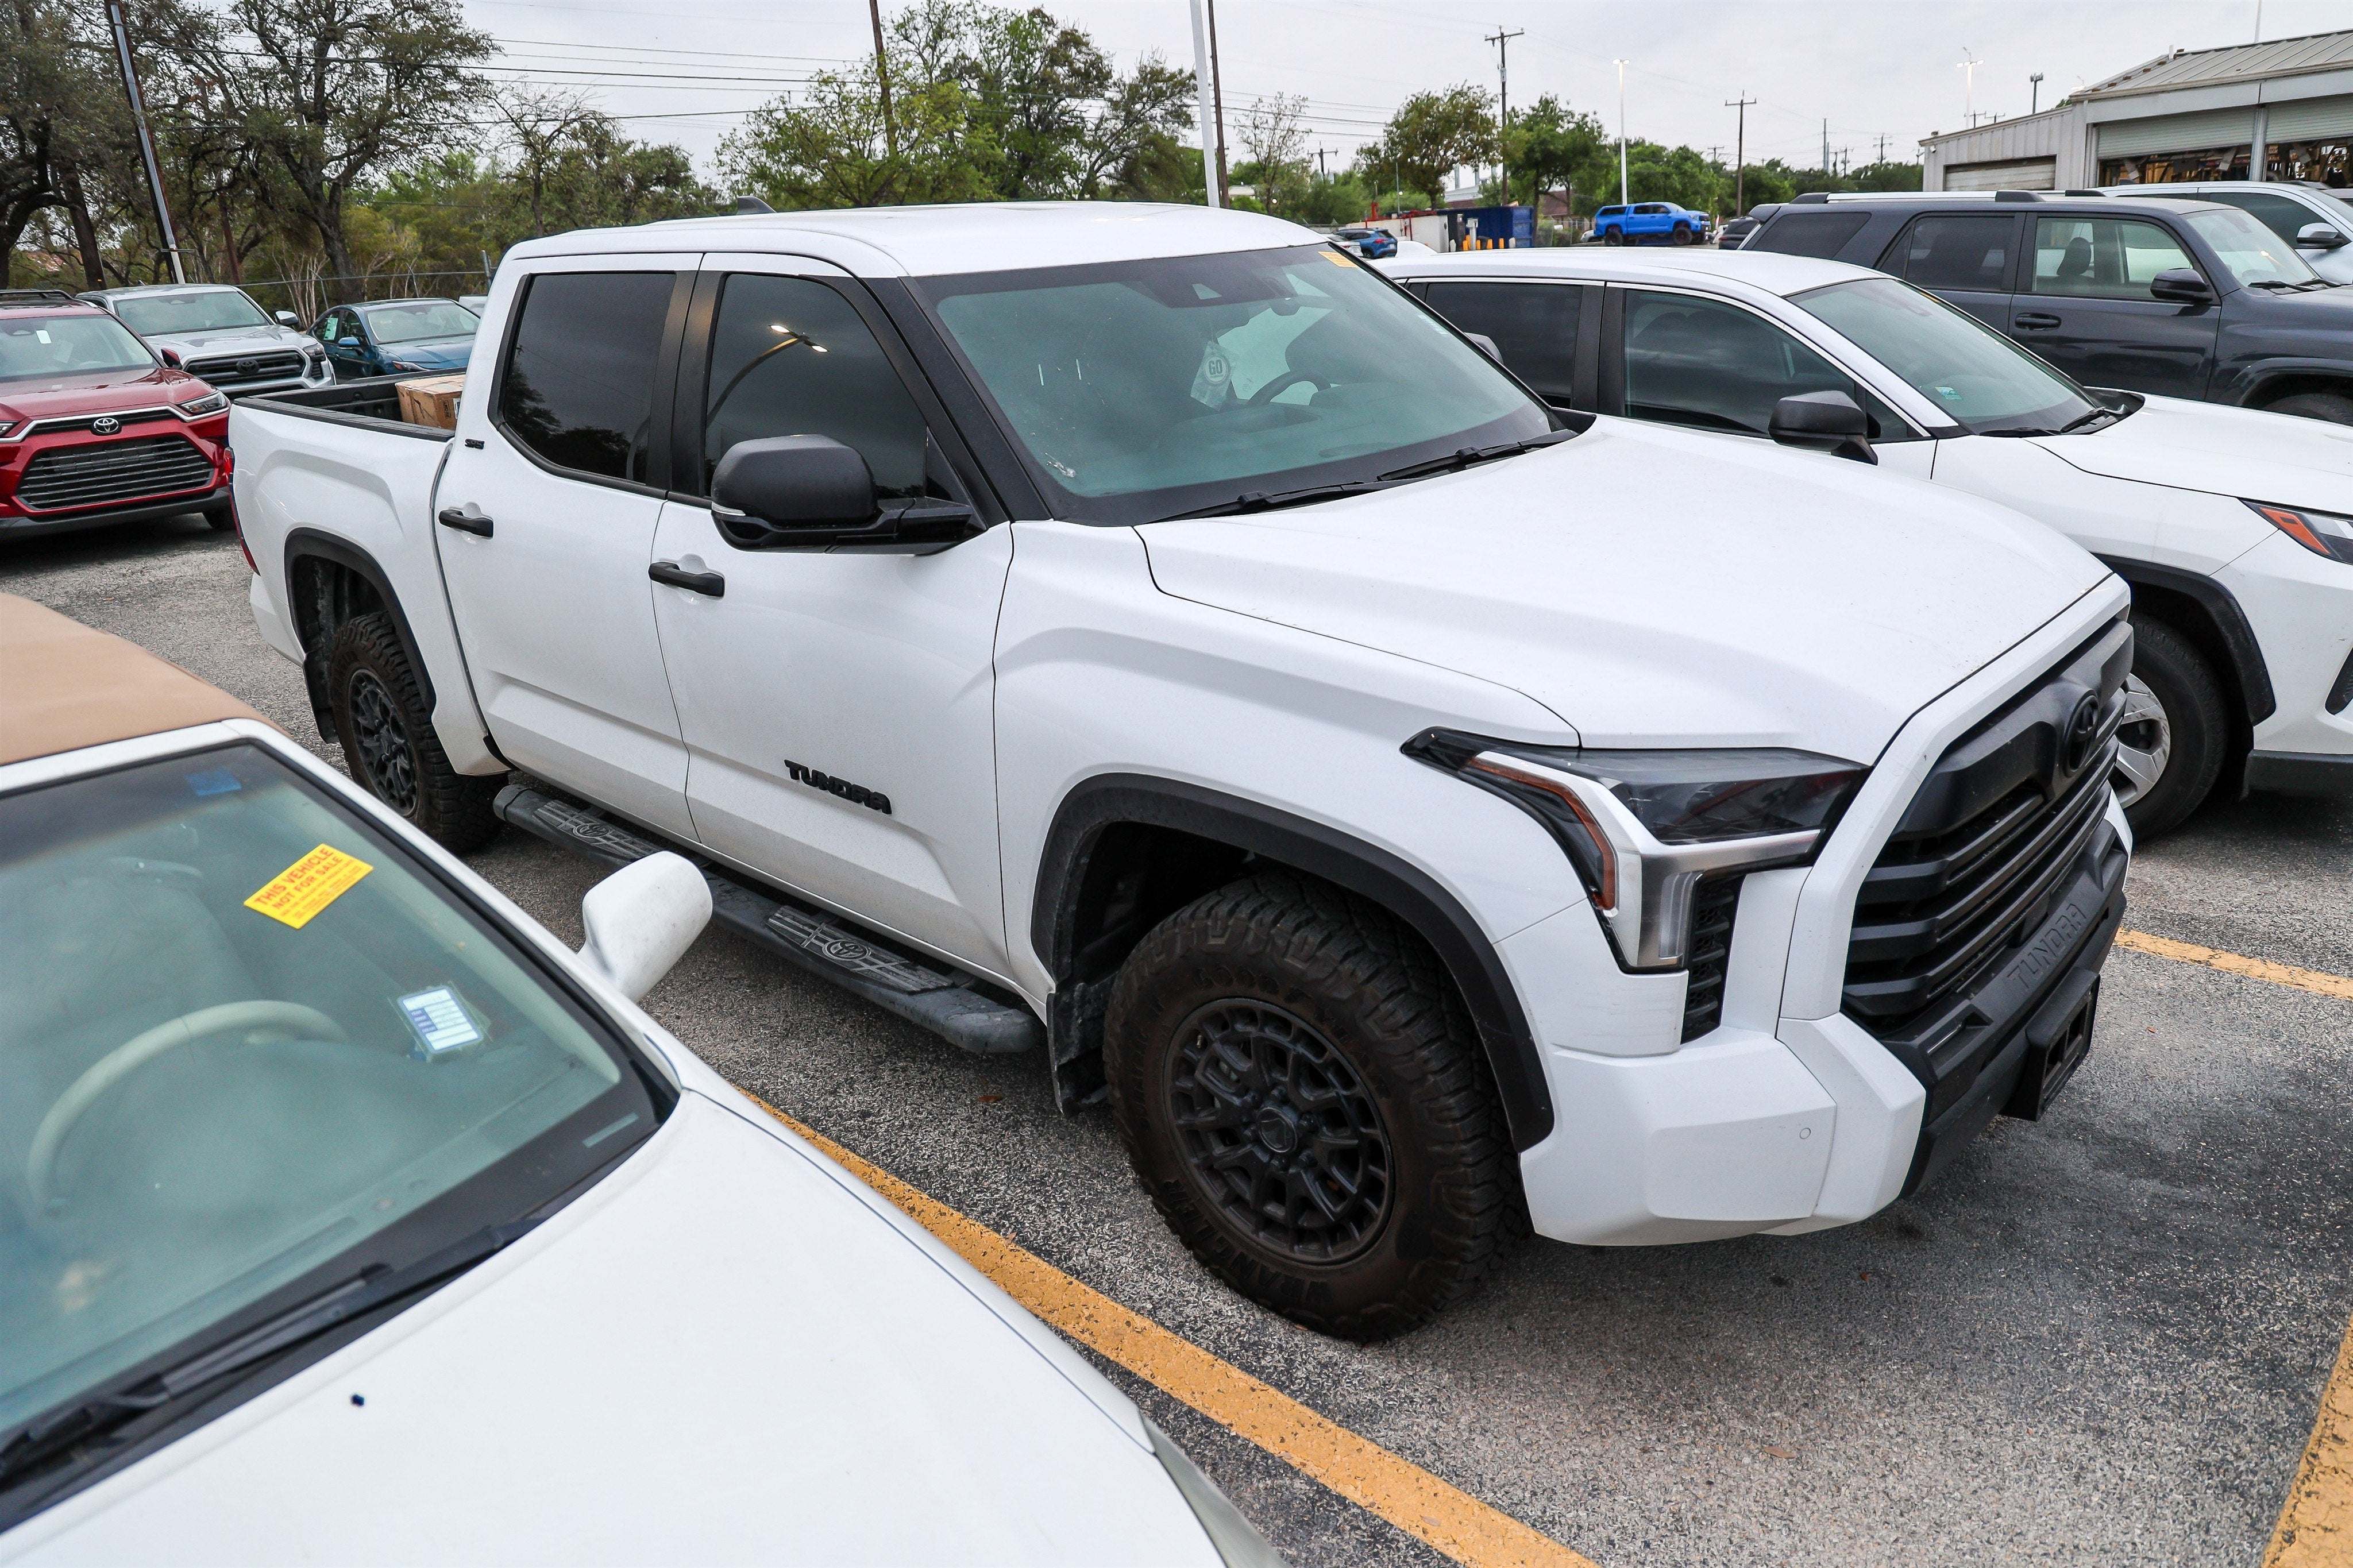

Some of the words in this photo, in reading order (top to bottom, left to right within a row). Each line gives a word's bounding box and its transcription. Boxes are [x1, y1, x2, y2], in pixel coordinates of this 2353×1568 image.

[1208, 359, 1223, 375] GO
[784, 759, 893, 814] TUNDRA
[254, 882, 287, 905] THIS
[281, 848, 334, 884] VEHICLE
[272, 891, 296, 909] NOT
[294, 875, 315, 893] FOR
[316, 856, 343, 875] SALE
[2007, 903, 2087, 989] TUNDRA
[1163, 1177, 1333, 1306] WRANGLER
